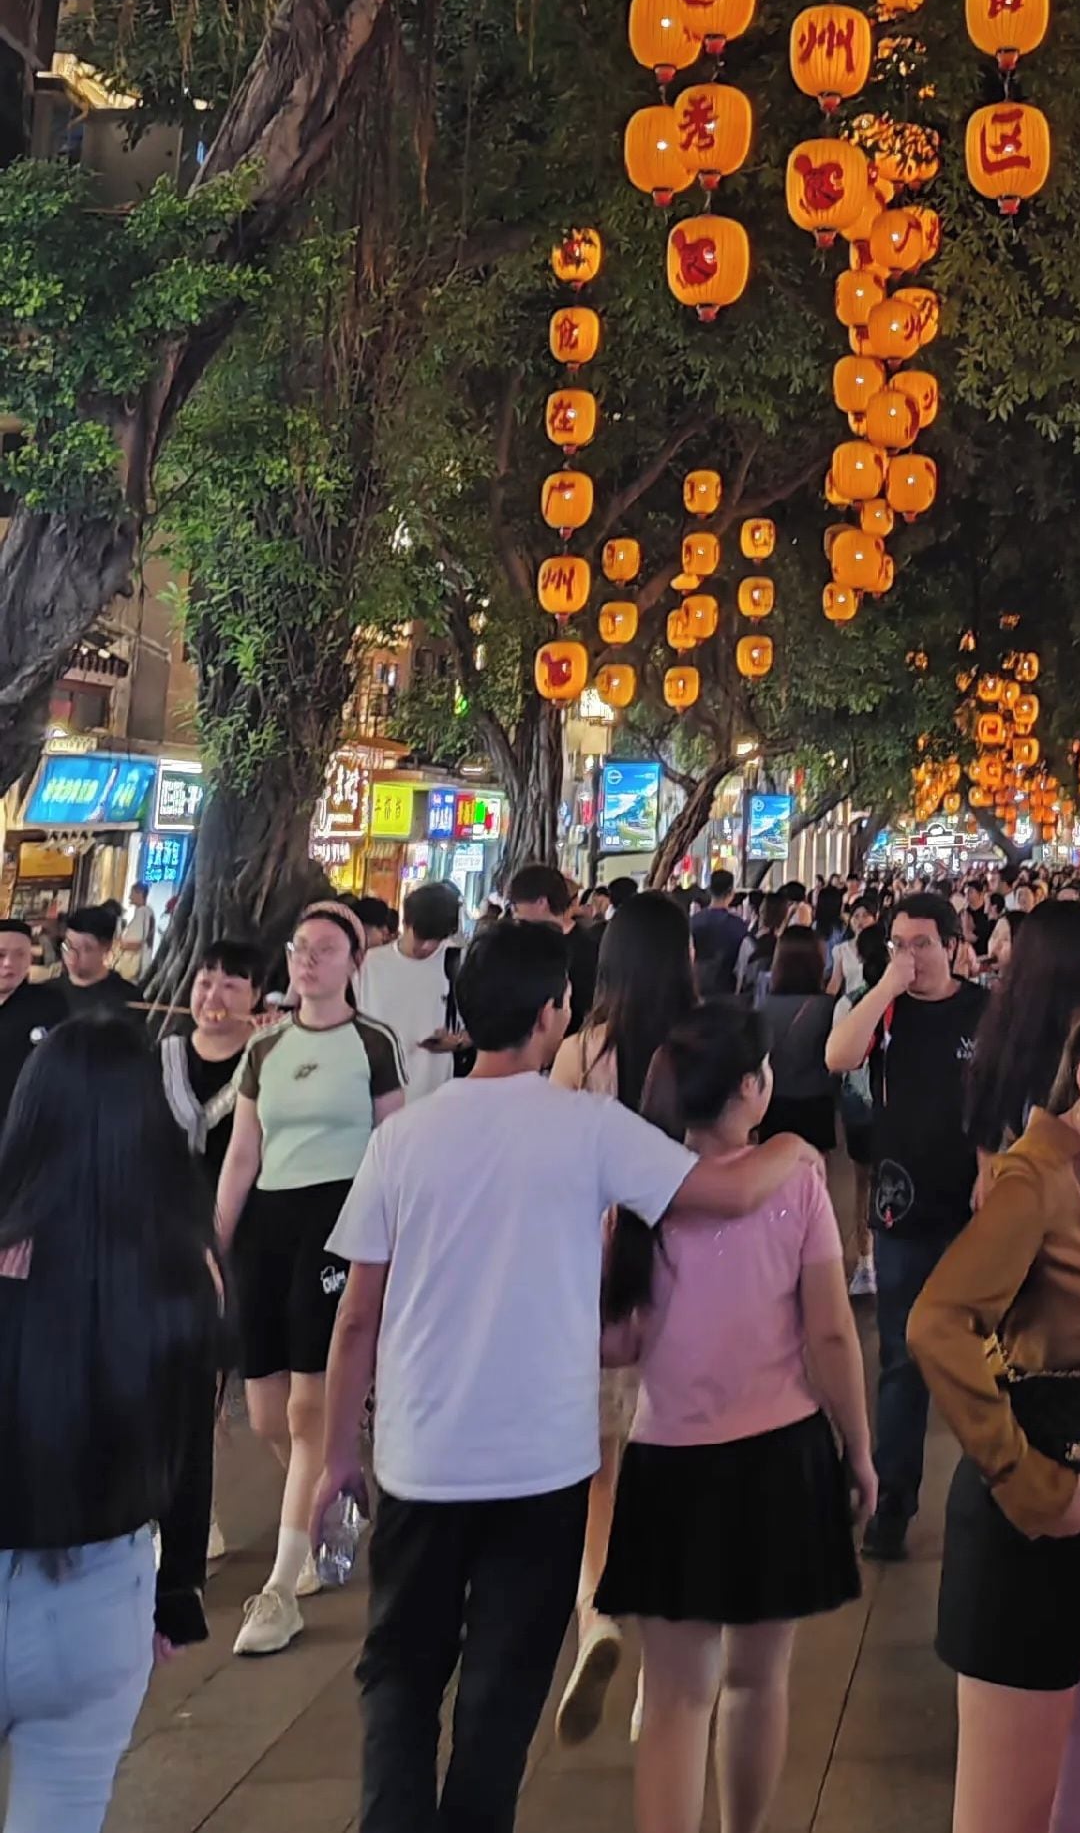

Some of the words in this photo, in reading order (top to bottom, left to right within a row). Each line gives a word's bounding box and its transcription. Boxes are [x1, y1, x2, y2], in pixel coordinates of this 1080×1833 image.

[799, 18, 856, 73] 州
[678, 93, 719, 152] 秀
[980, 108, 1032, 176] 区
[541, 565, 576, 603] 州
